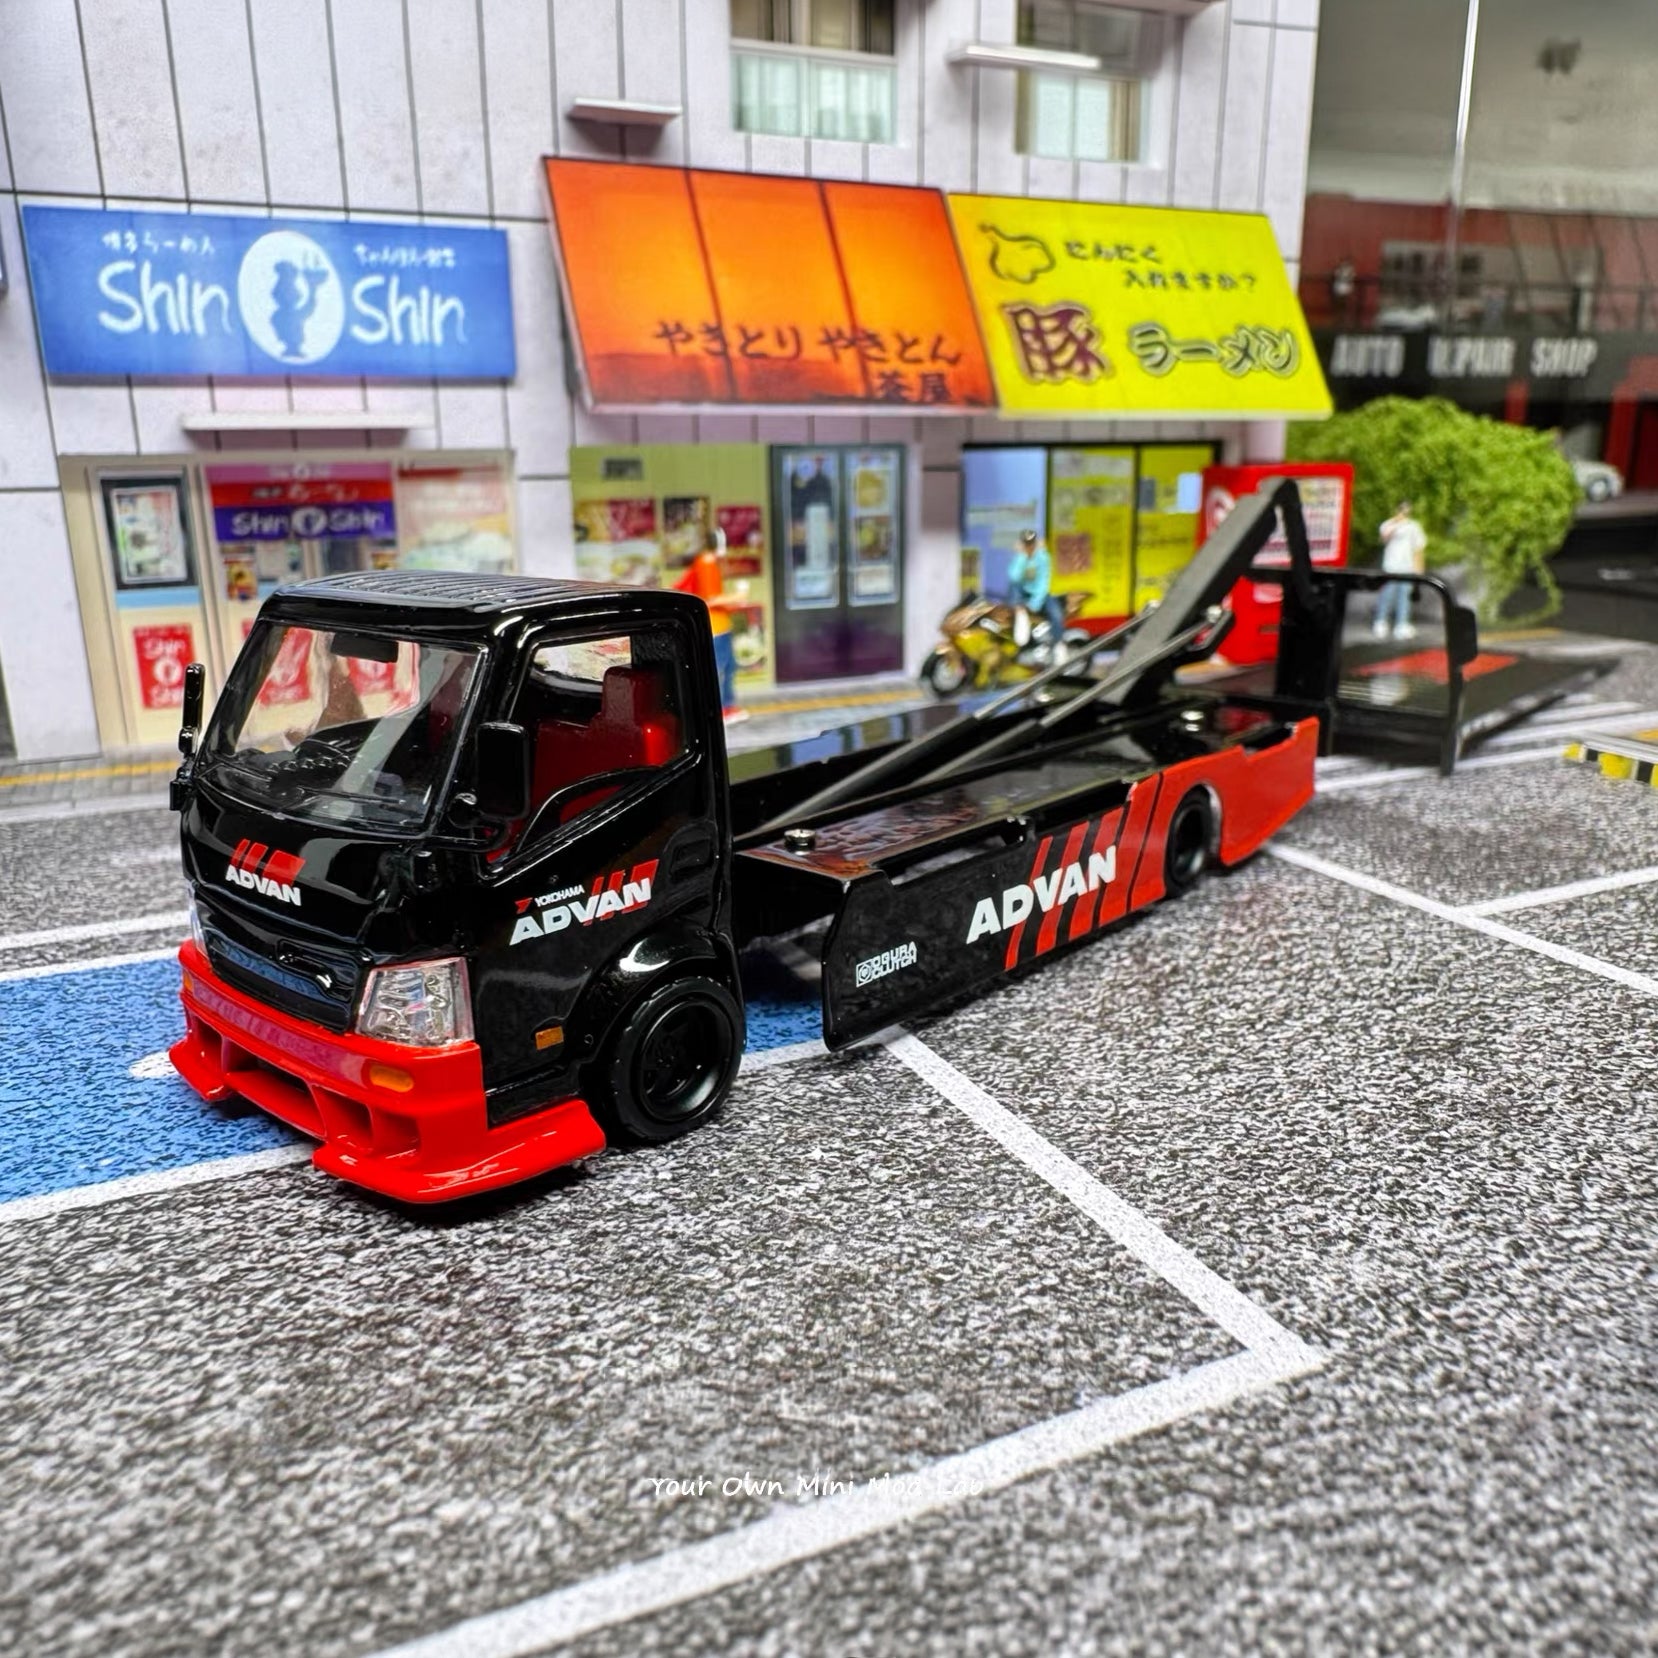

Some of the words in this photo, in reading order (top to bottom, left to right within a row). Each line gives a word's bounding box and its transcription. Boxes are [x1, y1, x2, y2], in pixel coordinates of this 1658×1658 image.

[98, 259, 232, 339] Shin
[350, 272, 468, 346] Shin
[653, 320, 803, 360] やきとり
[818, 325, 962, 366] やきとん
[1530, 336, 1598, 377] SHOP
[225, 864, 302, 907] ADVAN
[534, 884, 586, 907] YOKOHAMA
[966, 844, 1117, 945] ADVAN
[509, 877, 652, 946] ADVAN
